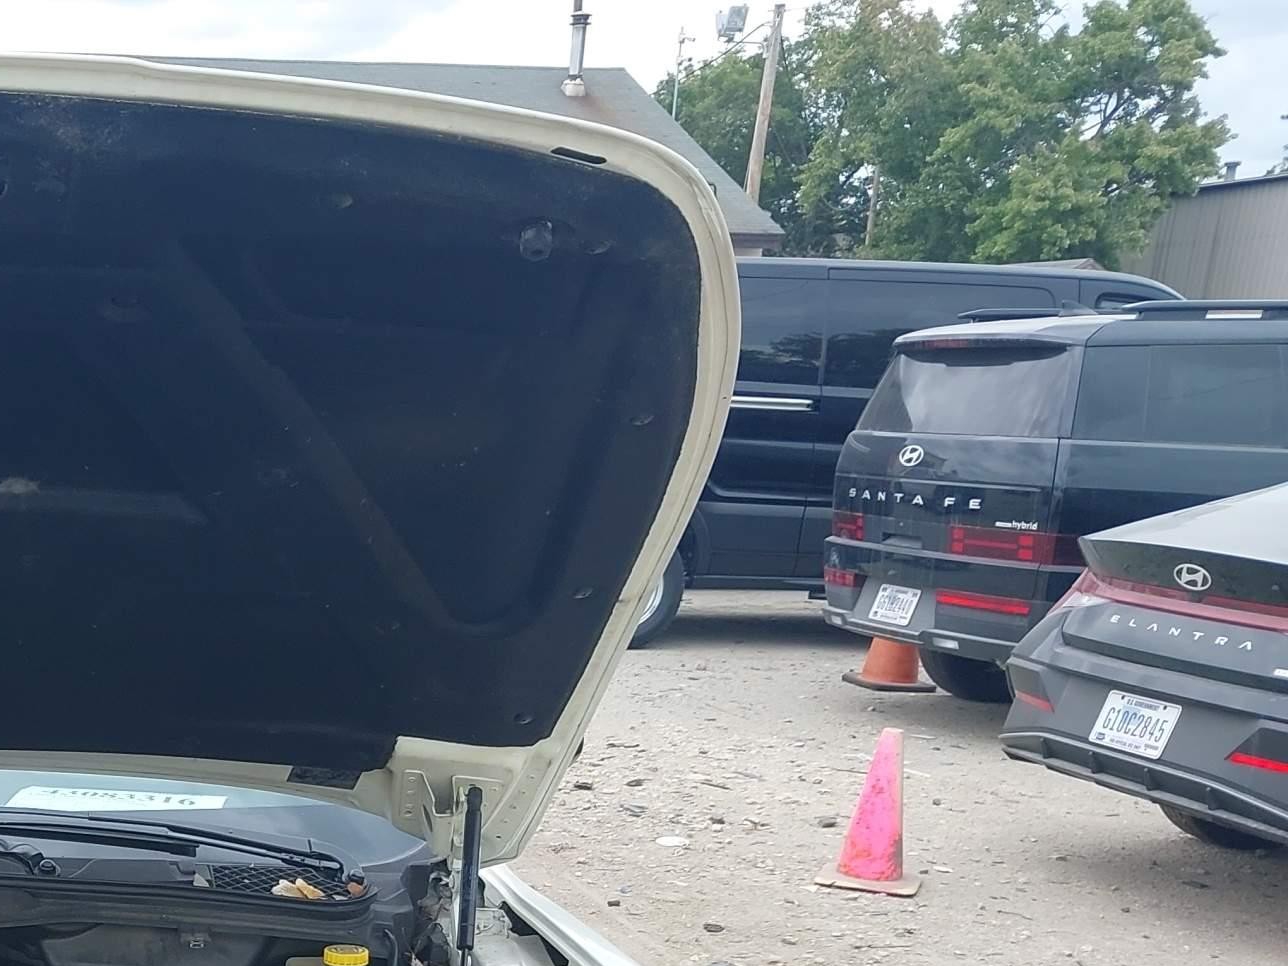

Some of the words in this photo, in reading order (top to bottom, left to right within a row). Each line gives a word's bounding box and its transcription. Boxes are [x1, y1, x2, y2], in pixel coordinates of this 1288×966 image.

[849, 488, 924, 505] SANTA
[944, 497, 981, 509] FE
[1012, 520, 1039, 530] hybrid
[1110, 615, 1253, 650] ELANTRA
